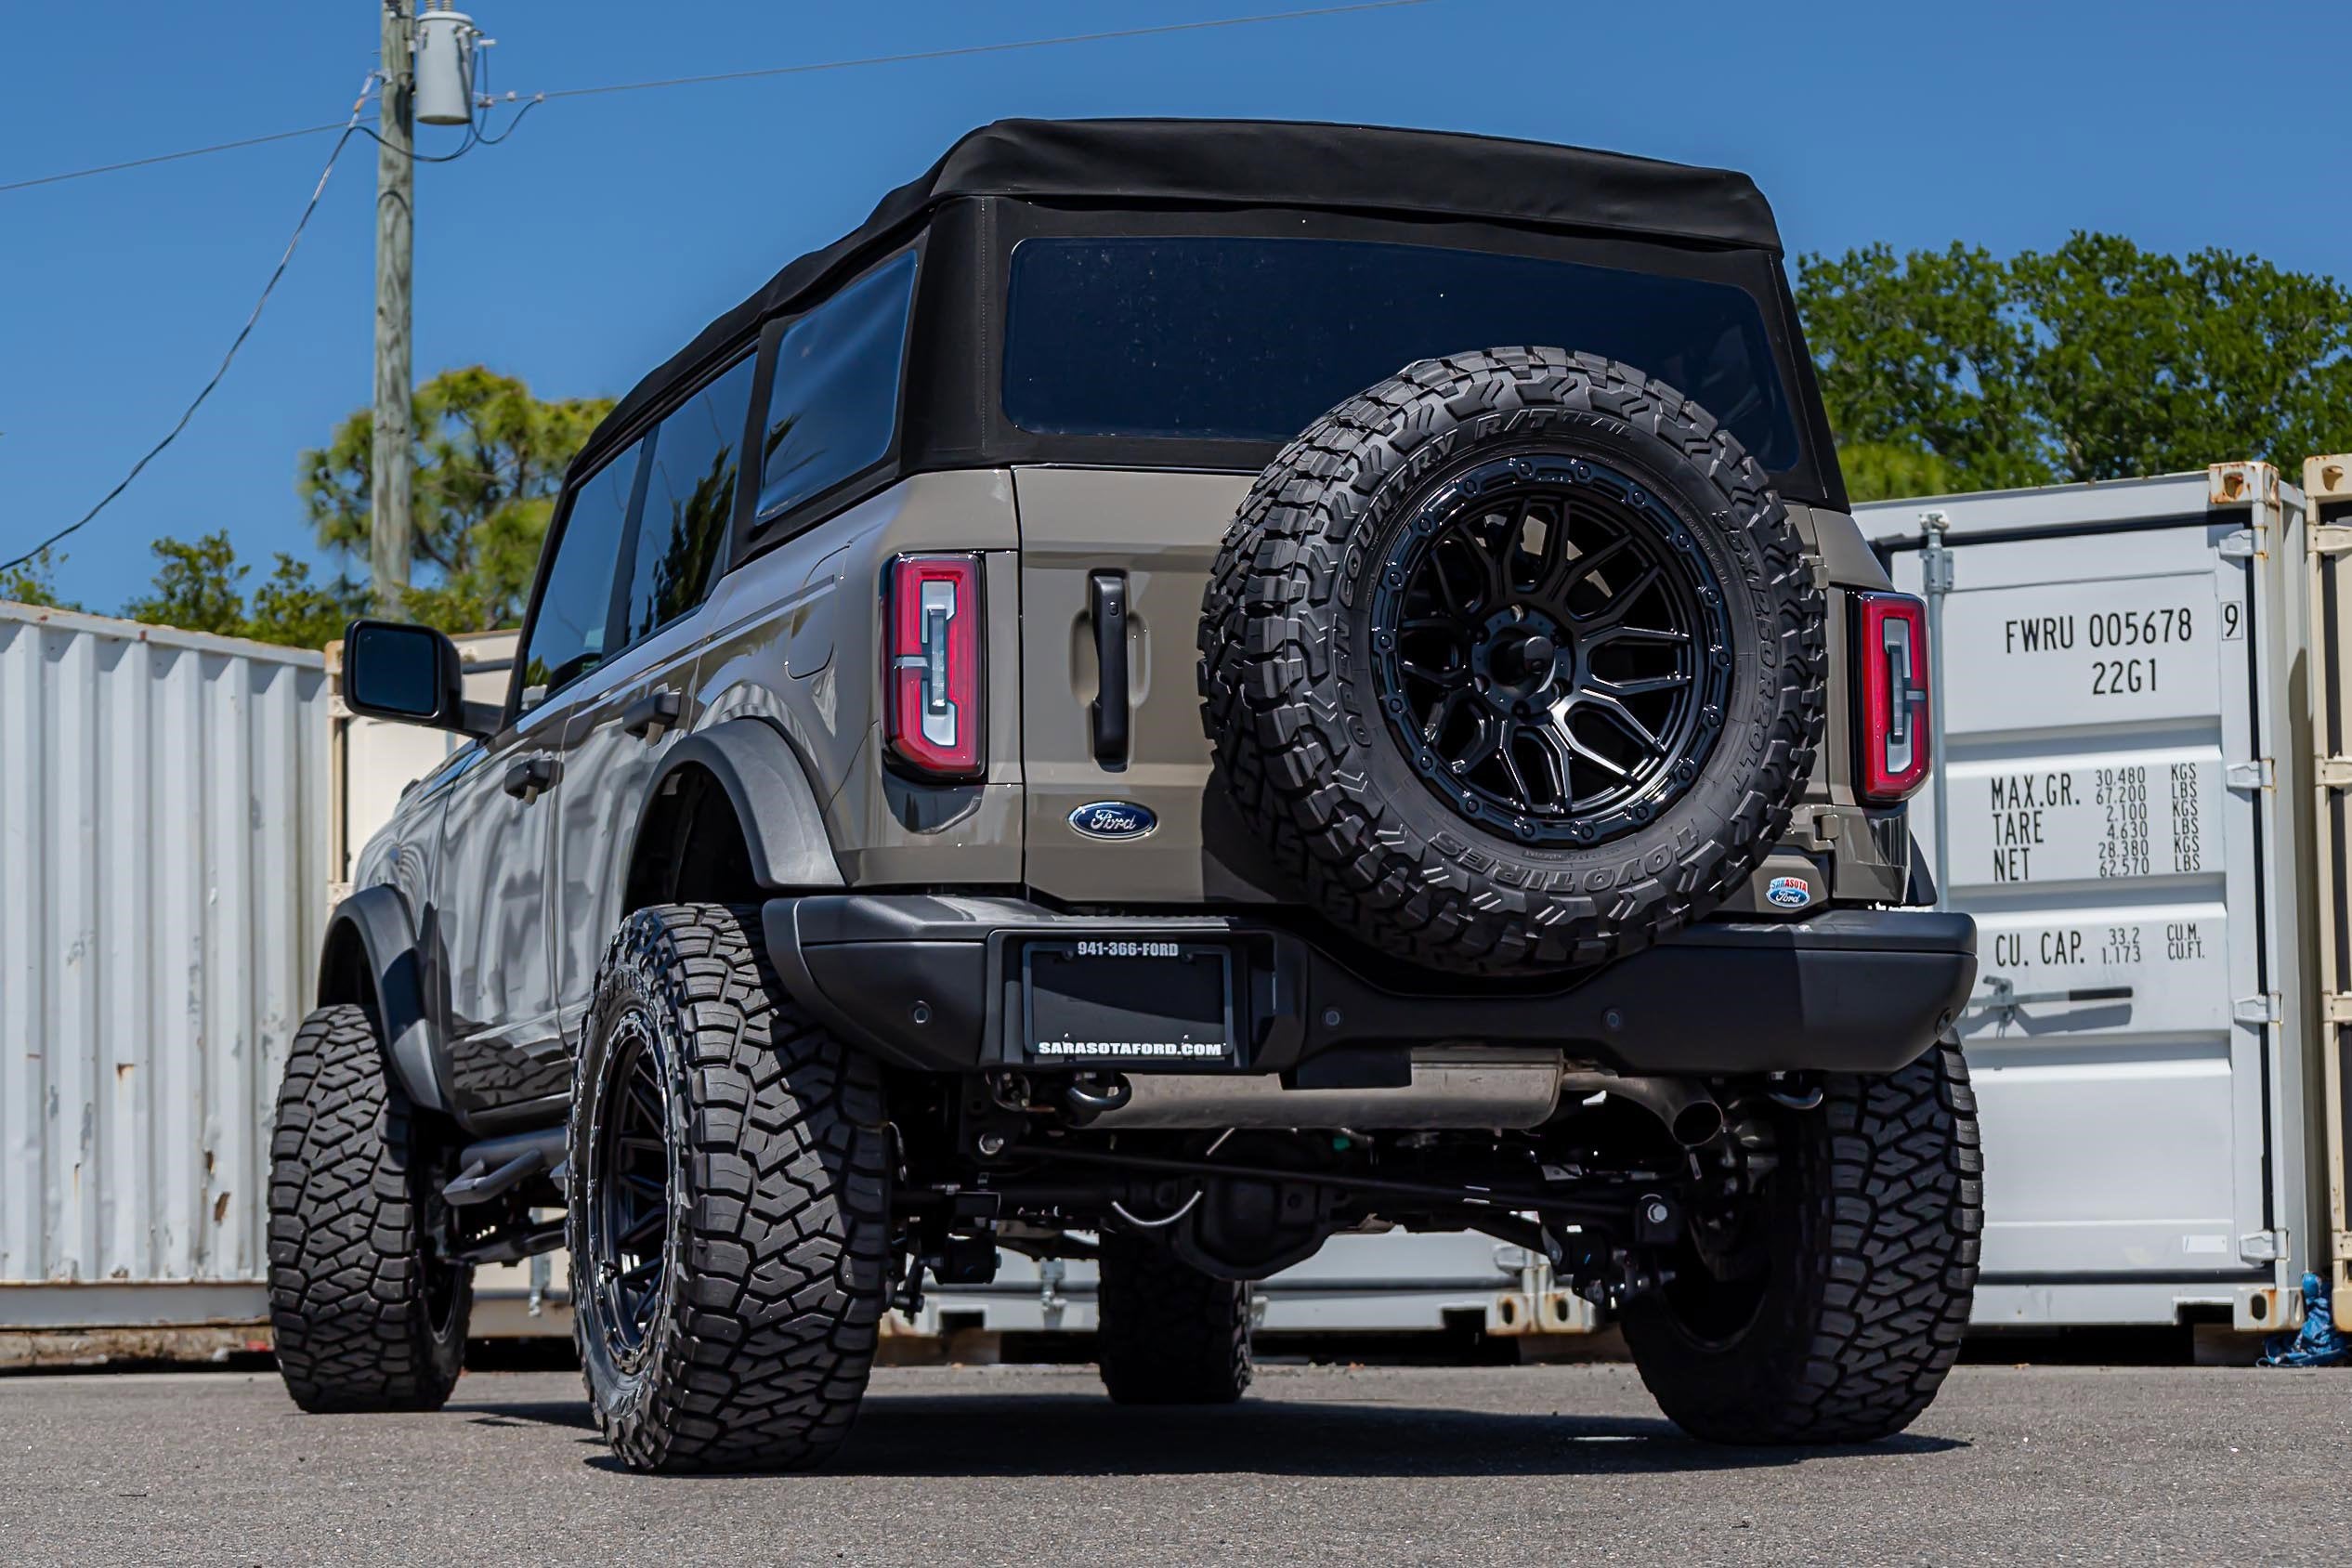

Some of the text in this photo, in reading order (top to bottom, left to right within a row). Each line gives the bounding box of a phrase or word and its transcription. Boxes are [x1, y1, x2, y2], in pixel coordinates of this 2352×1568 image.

[1337, 428, 1458, 608] COUNTRY
[1474, 409, 1558, 440] R/T
[2005, 603, 2240, 654] FWRU 005678 9
[2091, 658, 2158, 695] 22G1
[2096, 762, 2197, 787] 30.480 KGS
[2096, 780, 2198, 805] 67.200 LBS
[1090, 809, 1137, 830] Ford
[2106, 799, 2199, 822] 2.100 KGS
[1993, 810, 2044, 846] TARE
[2106, 817, 2200, 841] 4.630 LBS
[1429, 825, 1699, 894] TOYO TIRES
[2097, 835, 2200, 859] 28.380 KGS
[1993, 847, 2032, 882] NET
[2099, 853, 2201, 878] 62.570 LBS
[1775, 890, 1801, 903] Ford
[2109, 926, 2140, 946] 33.2
[1077, 941, 1179, 957] 941-366-FORD
[1995, 931, 2085, 967] CU. CAP.
[2102, 945, 2141, 964] 1.173
[1038, 1041, 1222, 1056] SARASOTAFORD.COM
